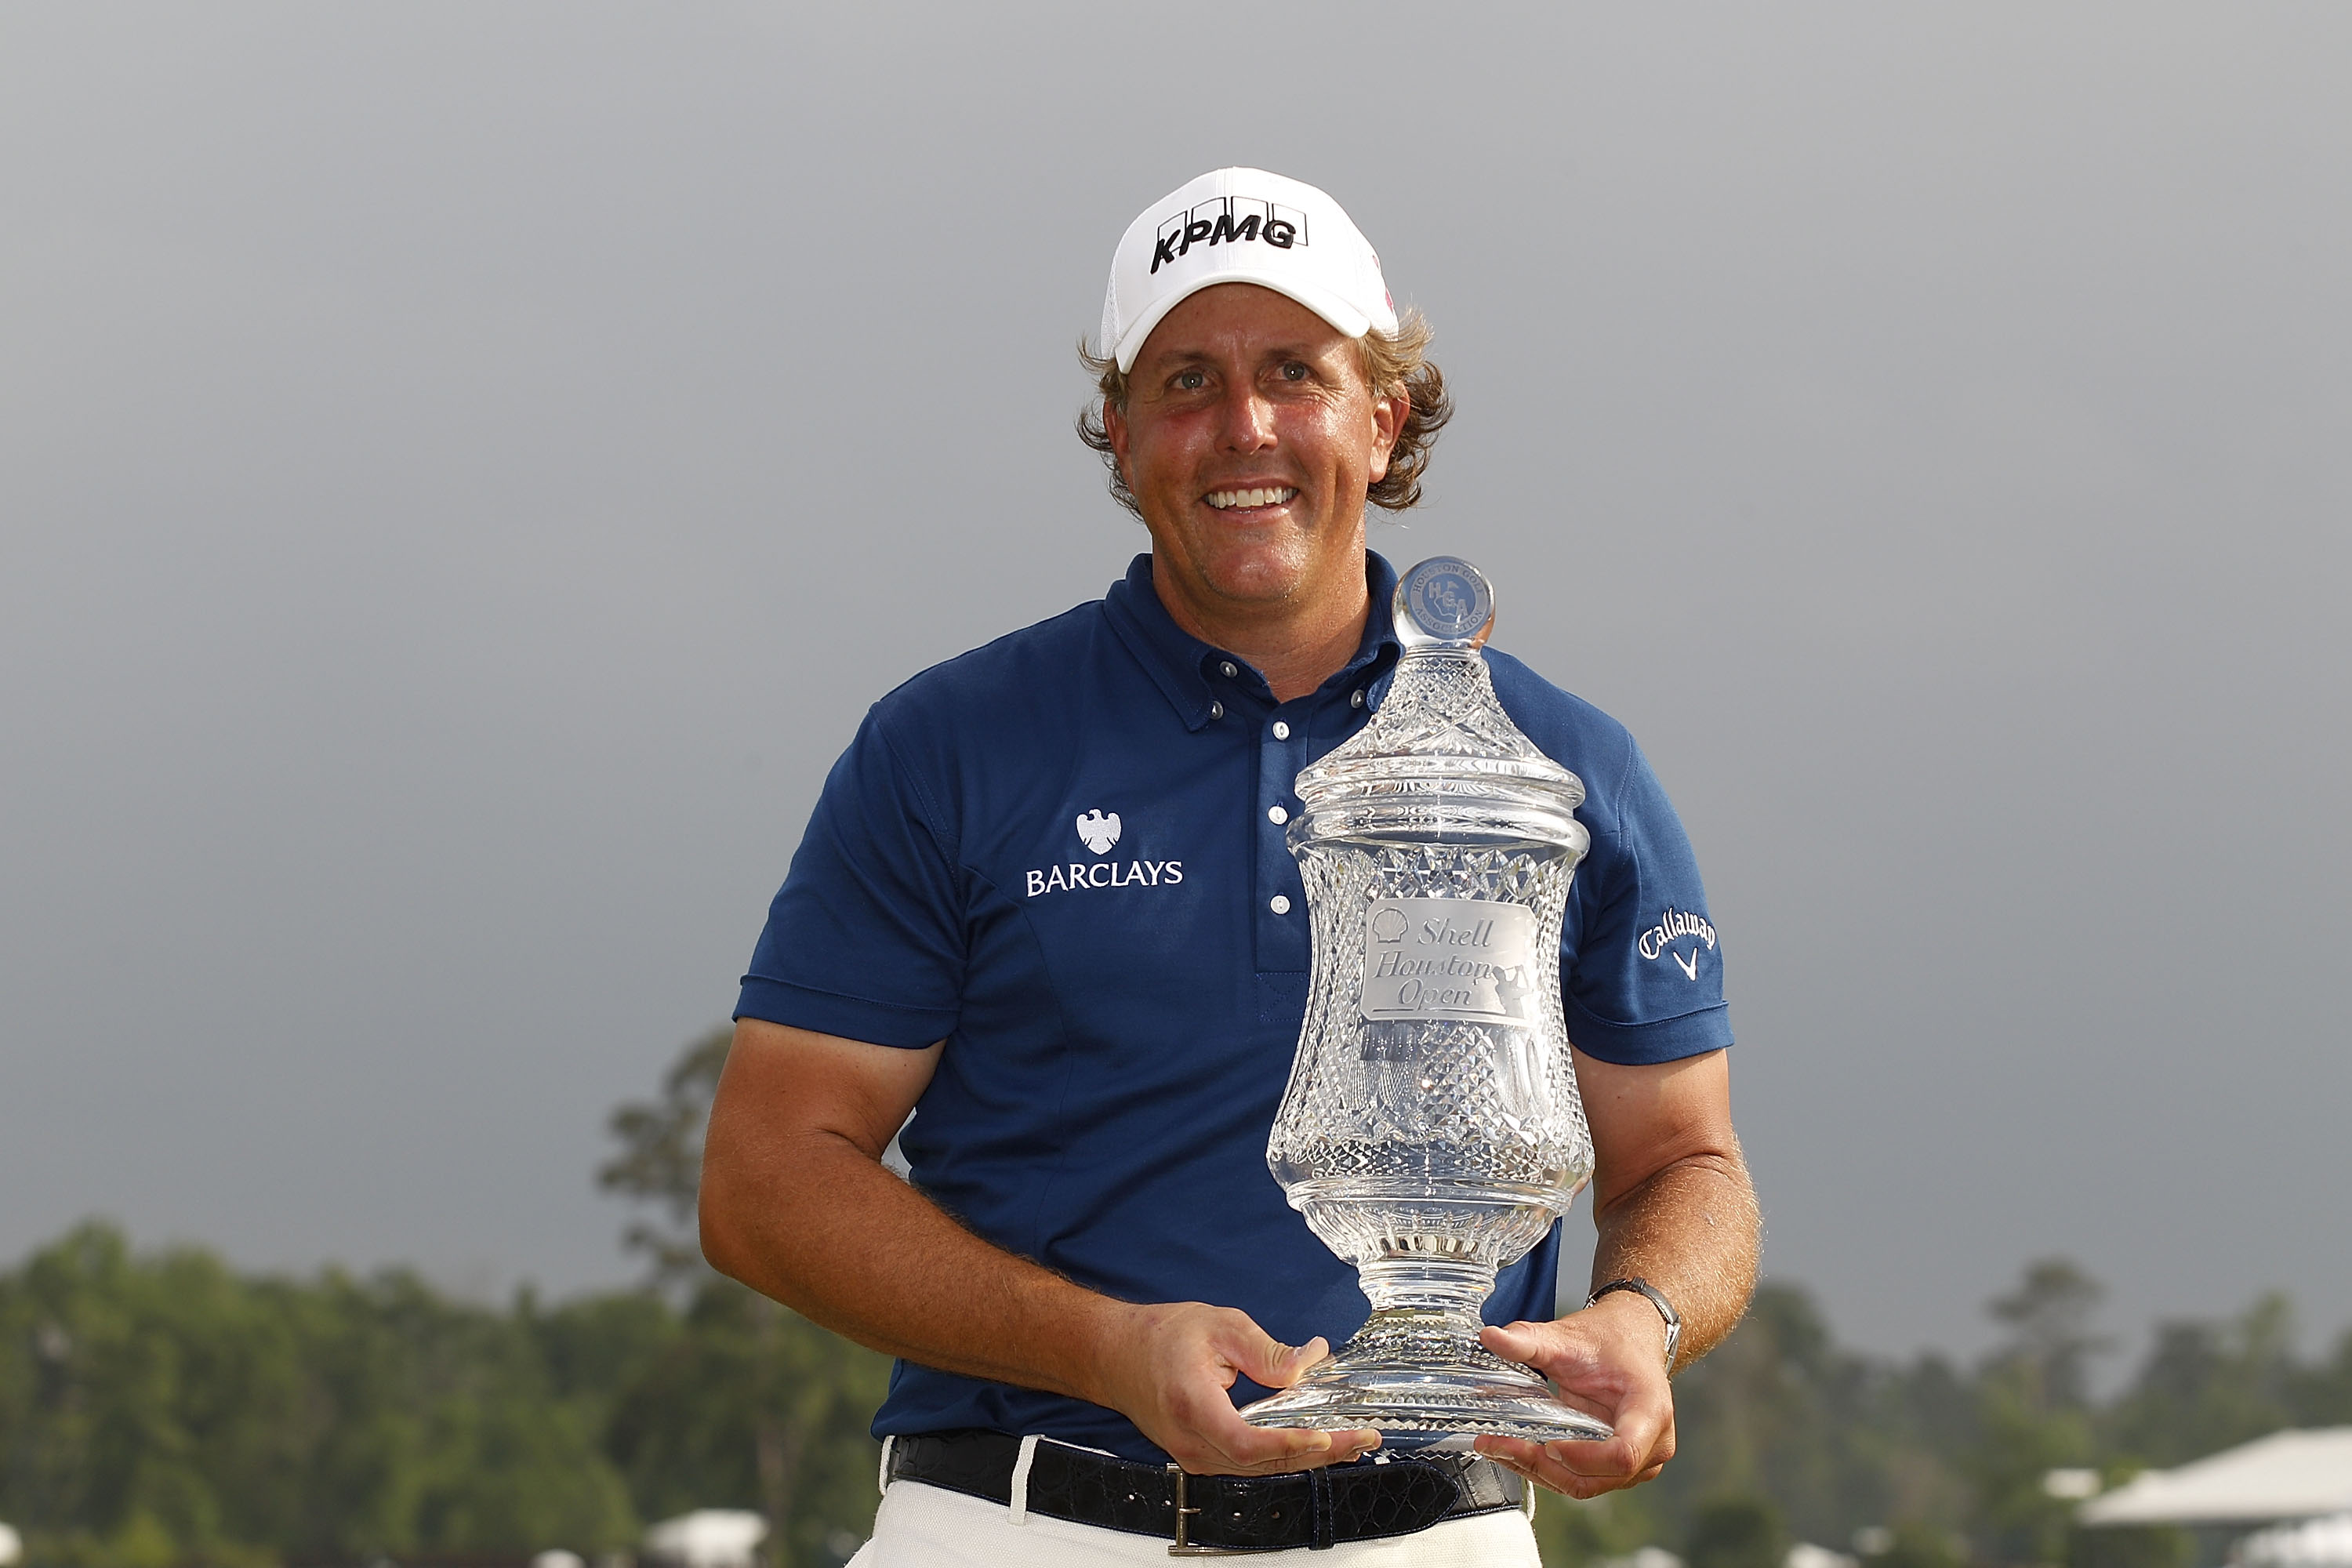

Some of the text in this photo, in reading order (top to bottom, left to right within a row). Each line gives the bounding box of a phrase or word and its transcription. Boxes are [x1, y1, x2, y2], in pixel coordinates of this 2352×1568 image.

[1150, 214, 1296, 274] KPMG
[1413, 564, 1459, 593] HOUSTON
[1025, 860, 1183, 898] BARCLAYS
[1417, 917, 1494, 947] Shell
[1639, 907, 1716, 960] Callaway
[1373, 949, 1494, 979] Houston
[1397, 978, 1472, 1011] Open
